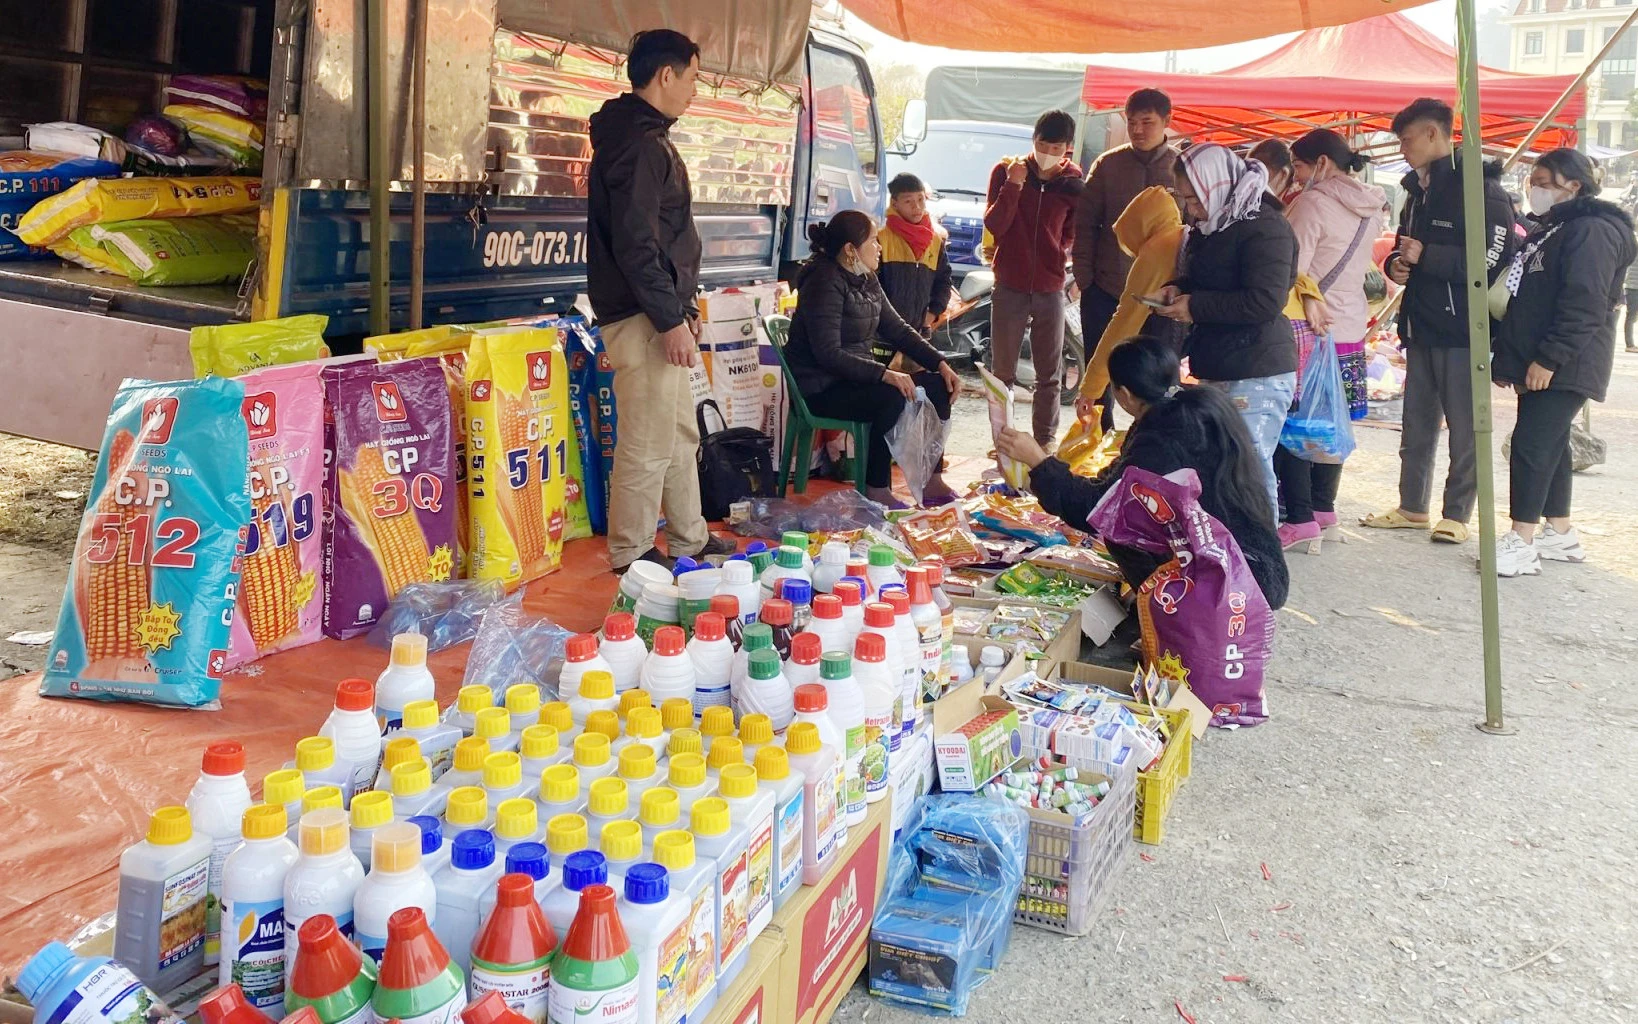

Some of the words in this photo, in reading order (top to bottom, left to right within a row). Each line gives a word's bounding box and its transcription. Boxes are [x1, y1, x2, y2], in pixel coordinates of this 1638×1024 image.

[29, 177, 60, 193] 111
[527, 415, 554, 441] C.P.
[174, 467, 192, 477] LAI
[383, 447, 418, 475] CP
[506, 439, 567, 490] 511
[114, 476, 173, 508] C.P.
[250, 466, 295, 499] C.P.
[372, 472, 443, 519] 3Q
[87, 512, 200, 569] 512
[1227, 590, 1248, 638] 3Q
[1224, 643, 1245, 680] CP
